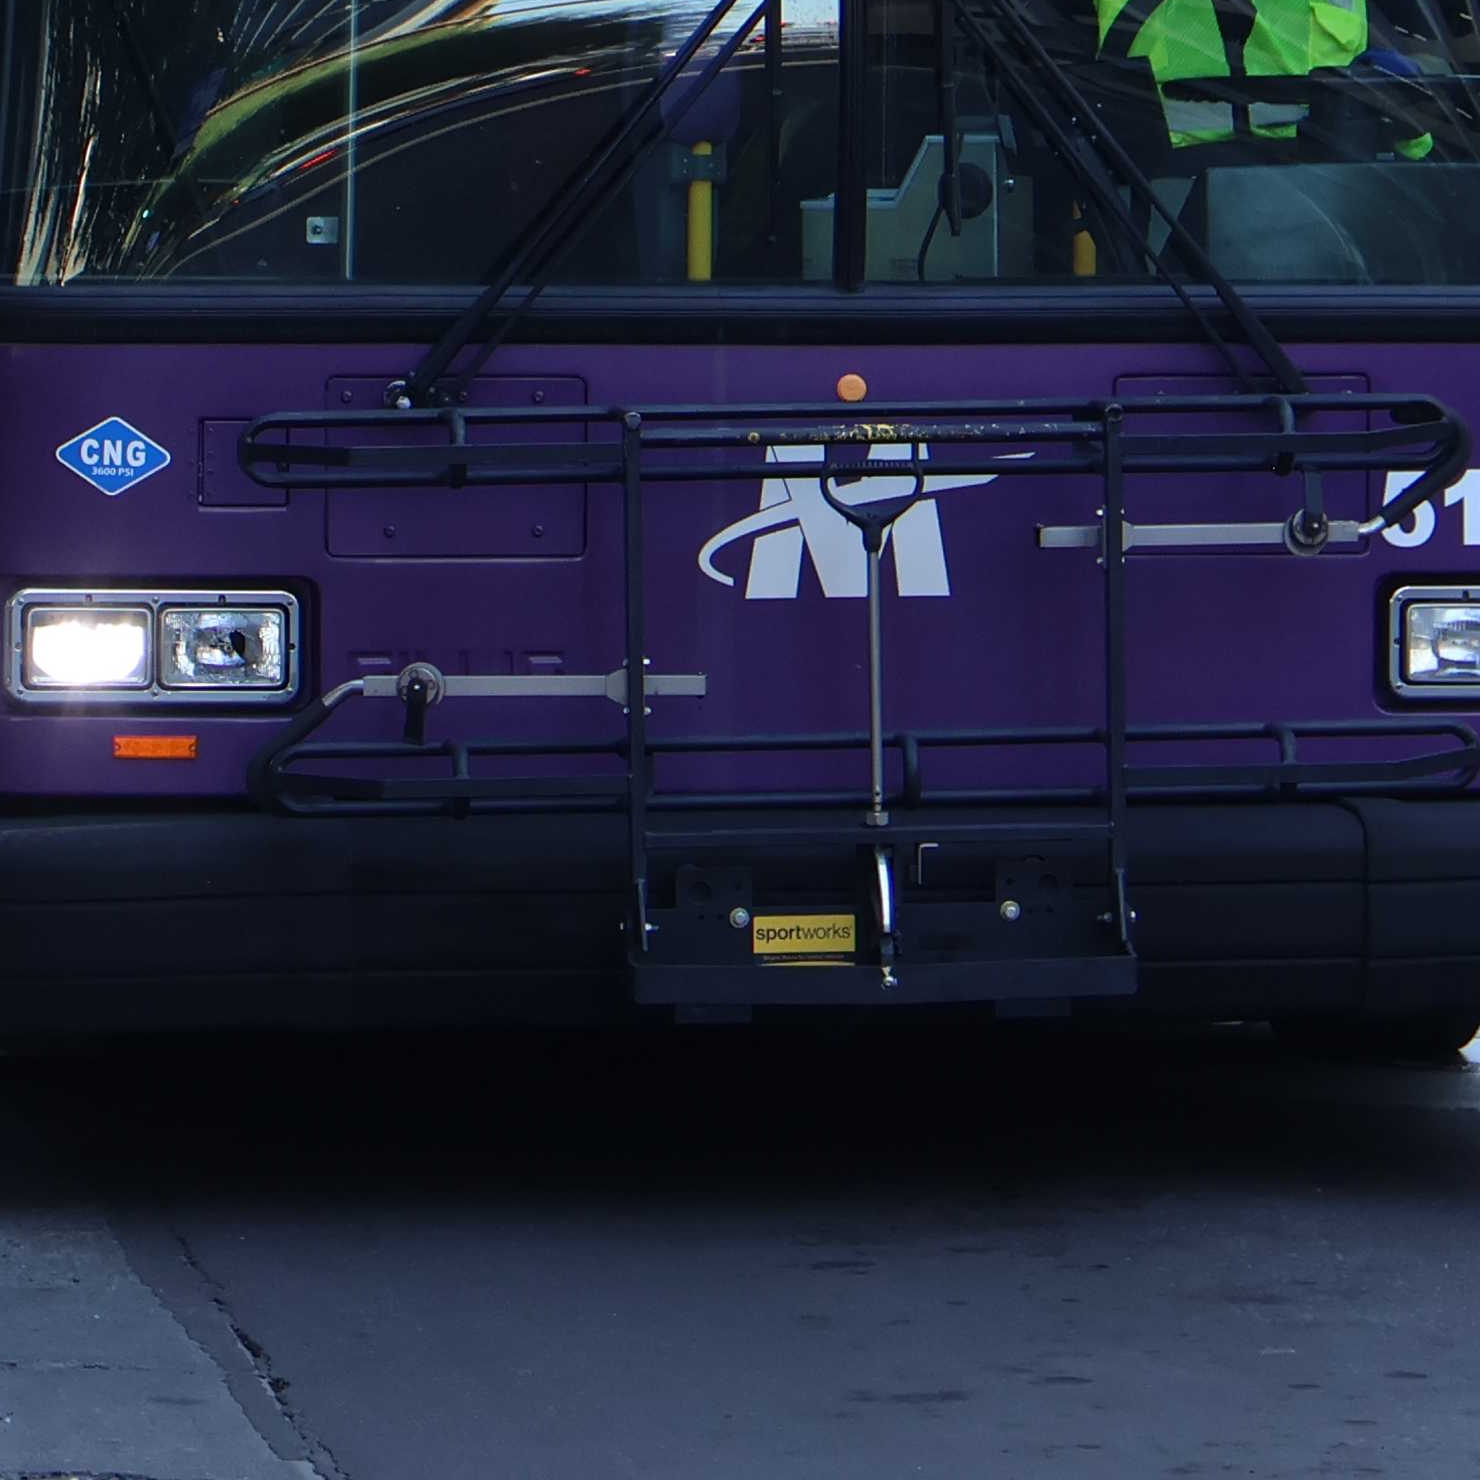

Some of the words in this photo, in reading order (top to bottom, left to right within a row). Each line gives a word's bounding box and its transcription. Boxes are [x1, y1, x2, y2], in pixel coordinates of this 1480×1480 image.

[80, 438, 147, 467] CNG
[91, 466, 116, 476] 3600
[118, 467, 134, 477] PSI
[755, 923, 851, 944] sportworks
